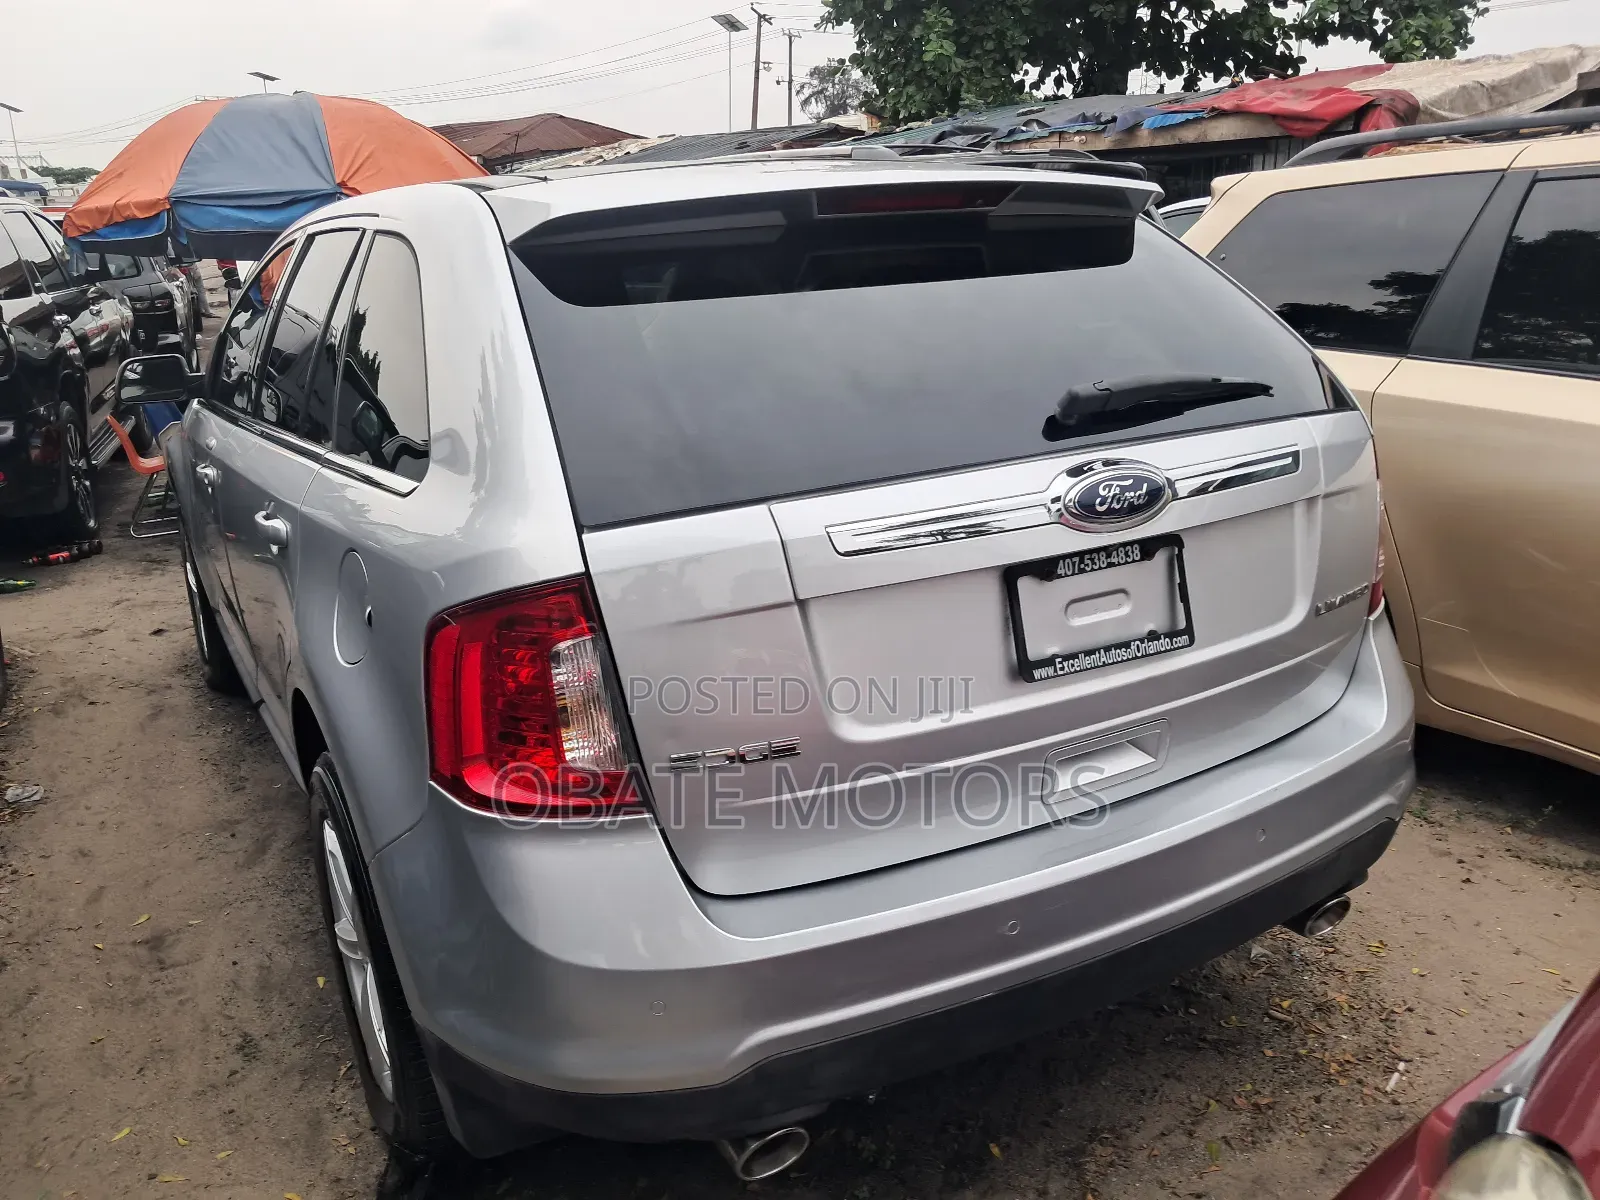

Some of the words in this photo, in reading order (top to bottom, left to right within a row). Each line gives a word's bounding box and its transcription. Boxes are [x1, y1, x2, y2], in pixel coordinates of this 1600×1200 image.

[1095, 479, 1148, 512] Ford
[1056, 543, 1141, 577] 407-538-4838
[1032, 634, 1190, 680] www.ExcellentAutosofOrlando.com
[669, 736, 801, 771] EDGE
